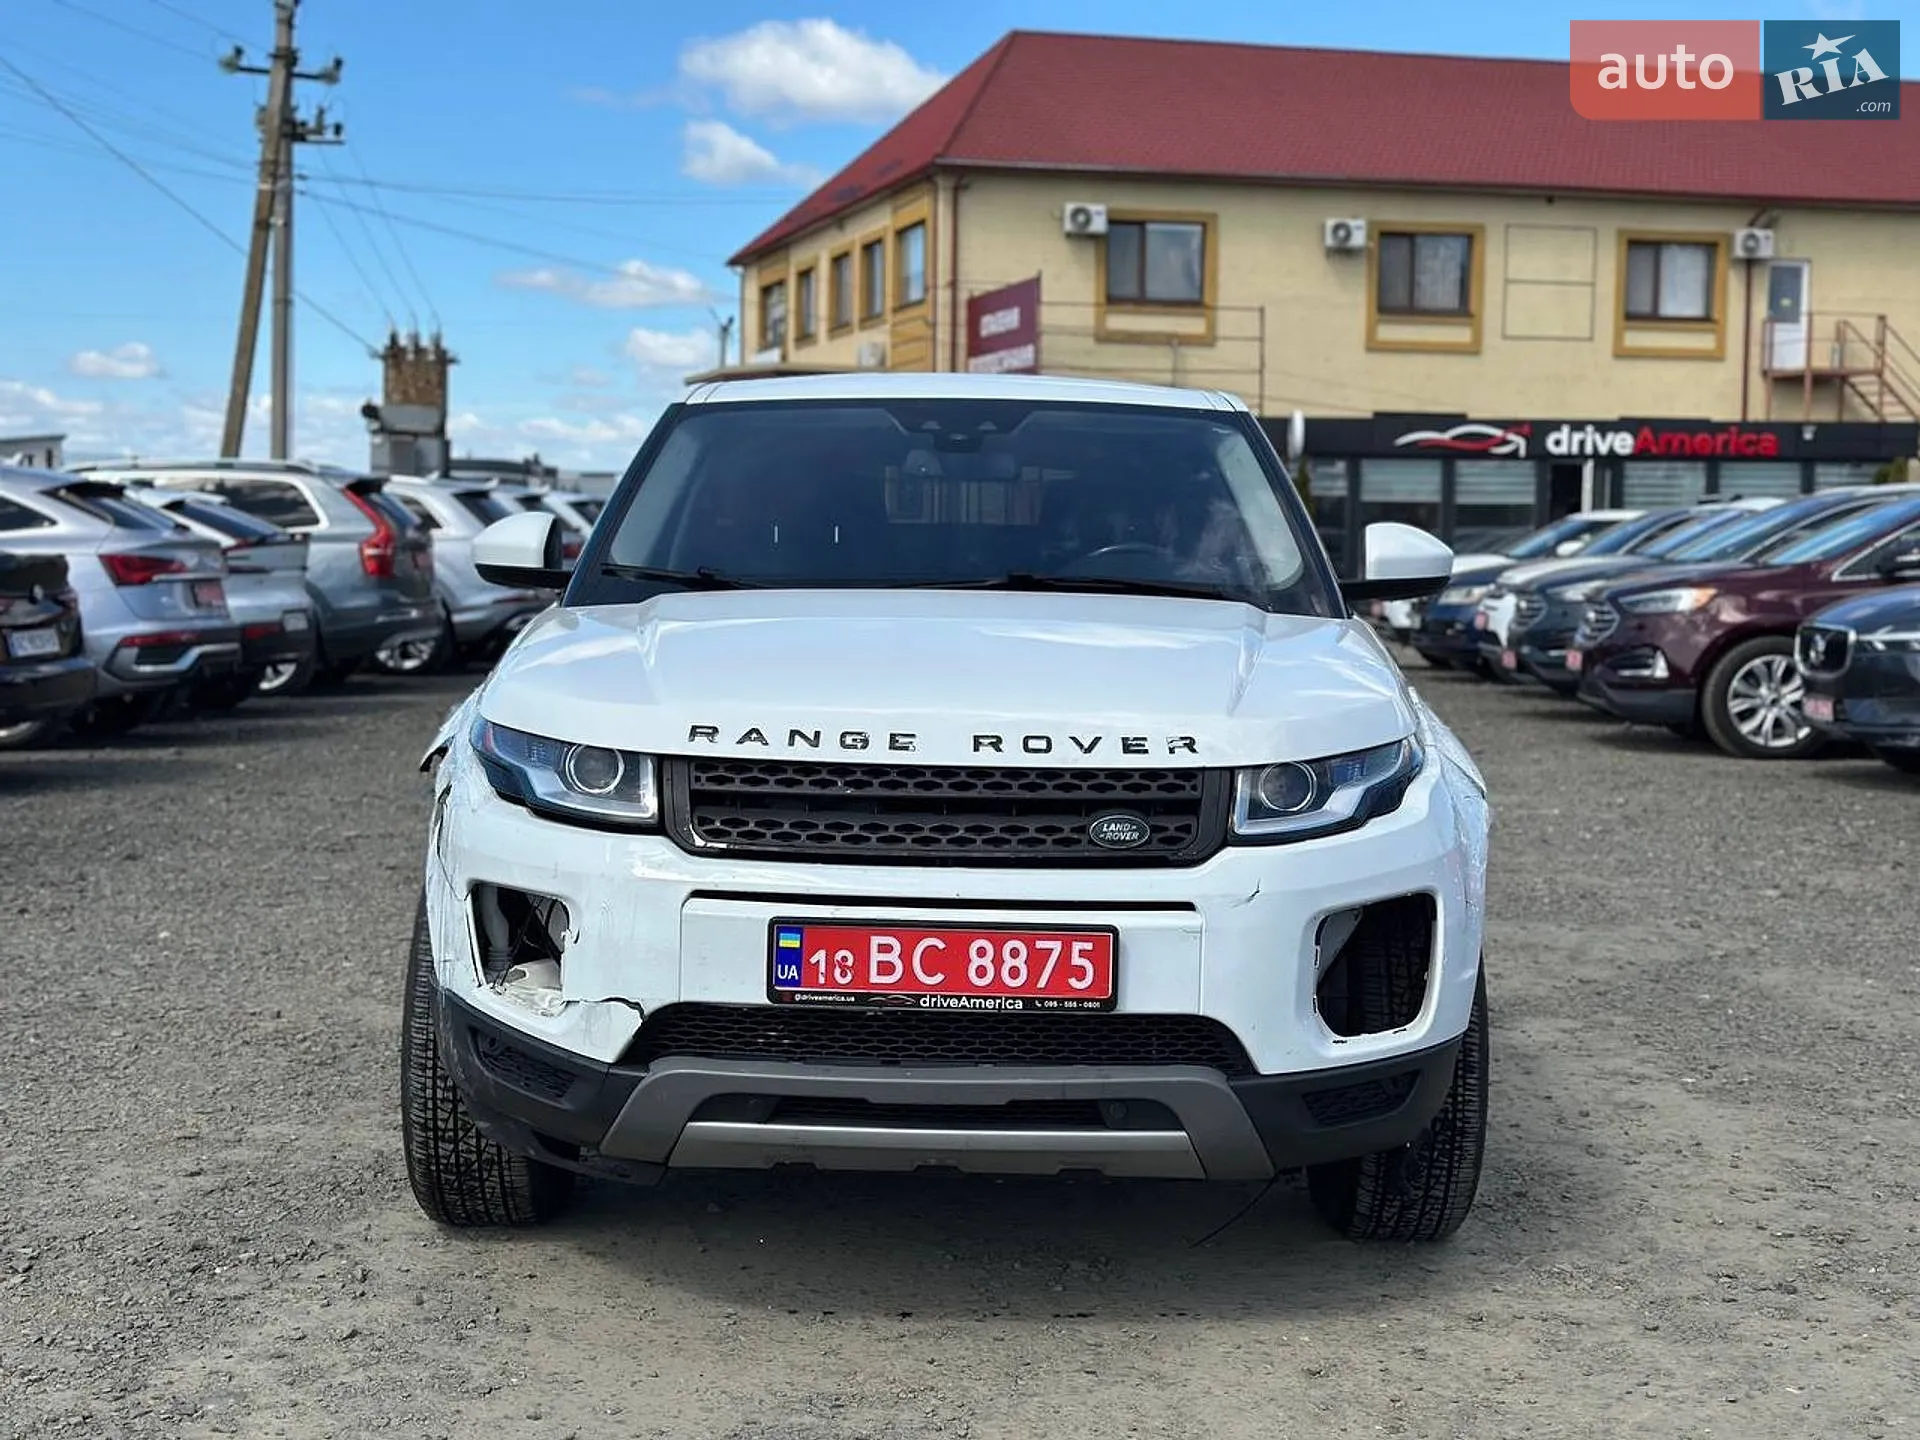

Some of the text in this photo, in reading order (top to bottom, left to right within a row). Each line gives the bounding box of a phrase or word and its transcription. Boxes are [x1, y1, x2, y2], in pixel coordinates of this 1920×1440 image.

[1545, 423, 1779, 457] driveAmerica
[687, 724, 1200, 755] RANGE ROVER
[777, 964, 799, 980] UA
[869, 935, 946, 986] BC
[967, 938, 1095, 990] 8875
[919, 994, 1023, 1010] driveAmerica
